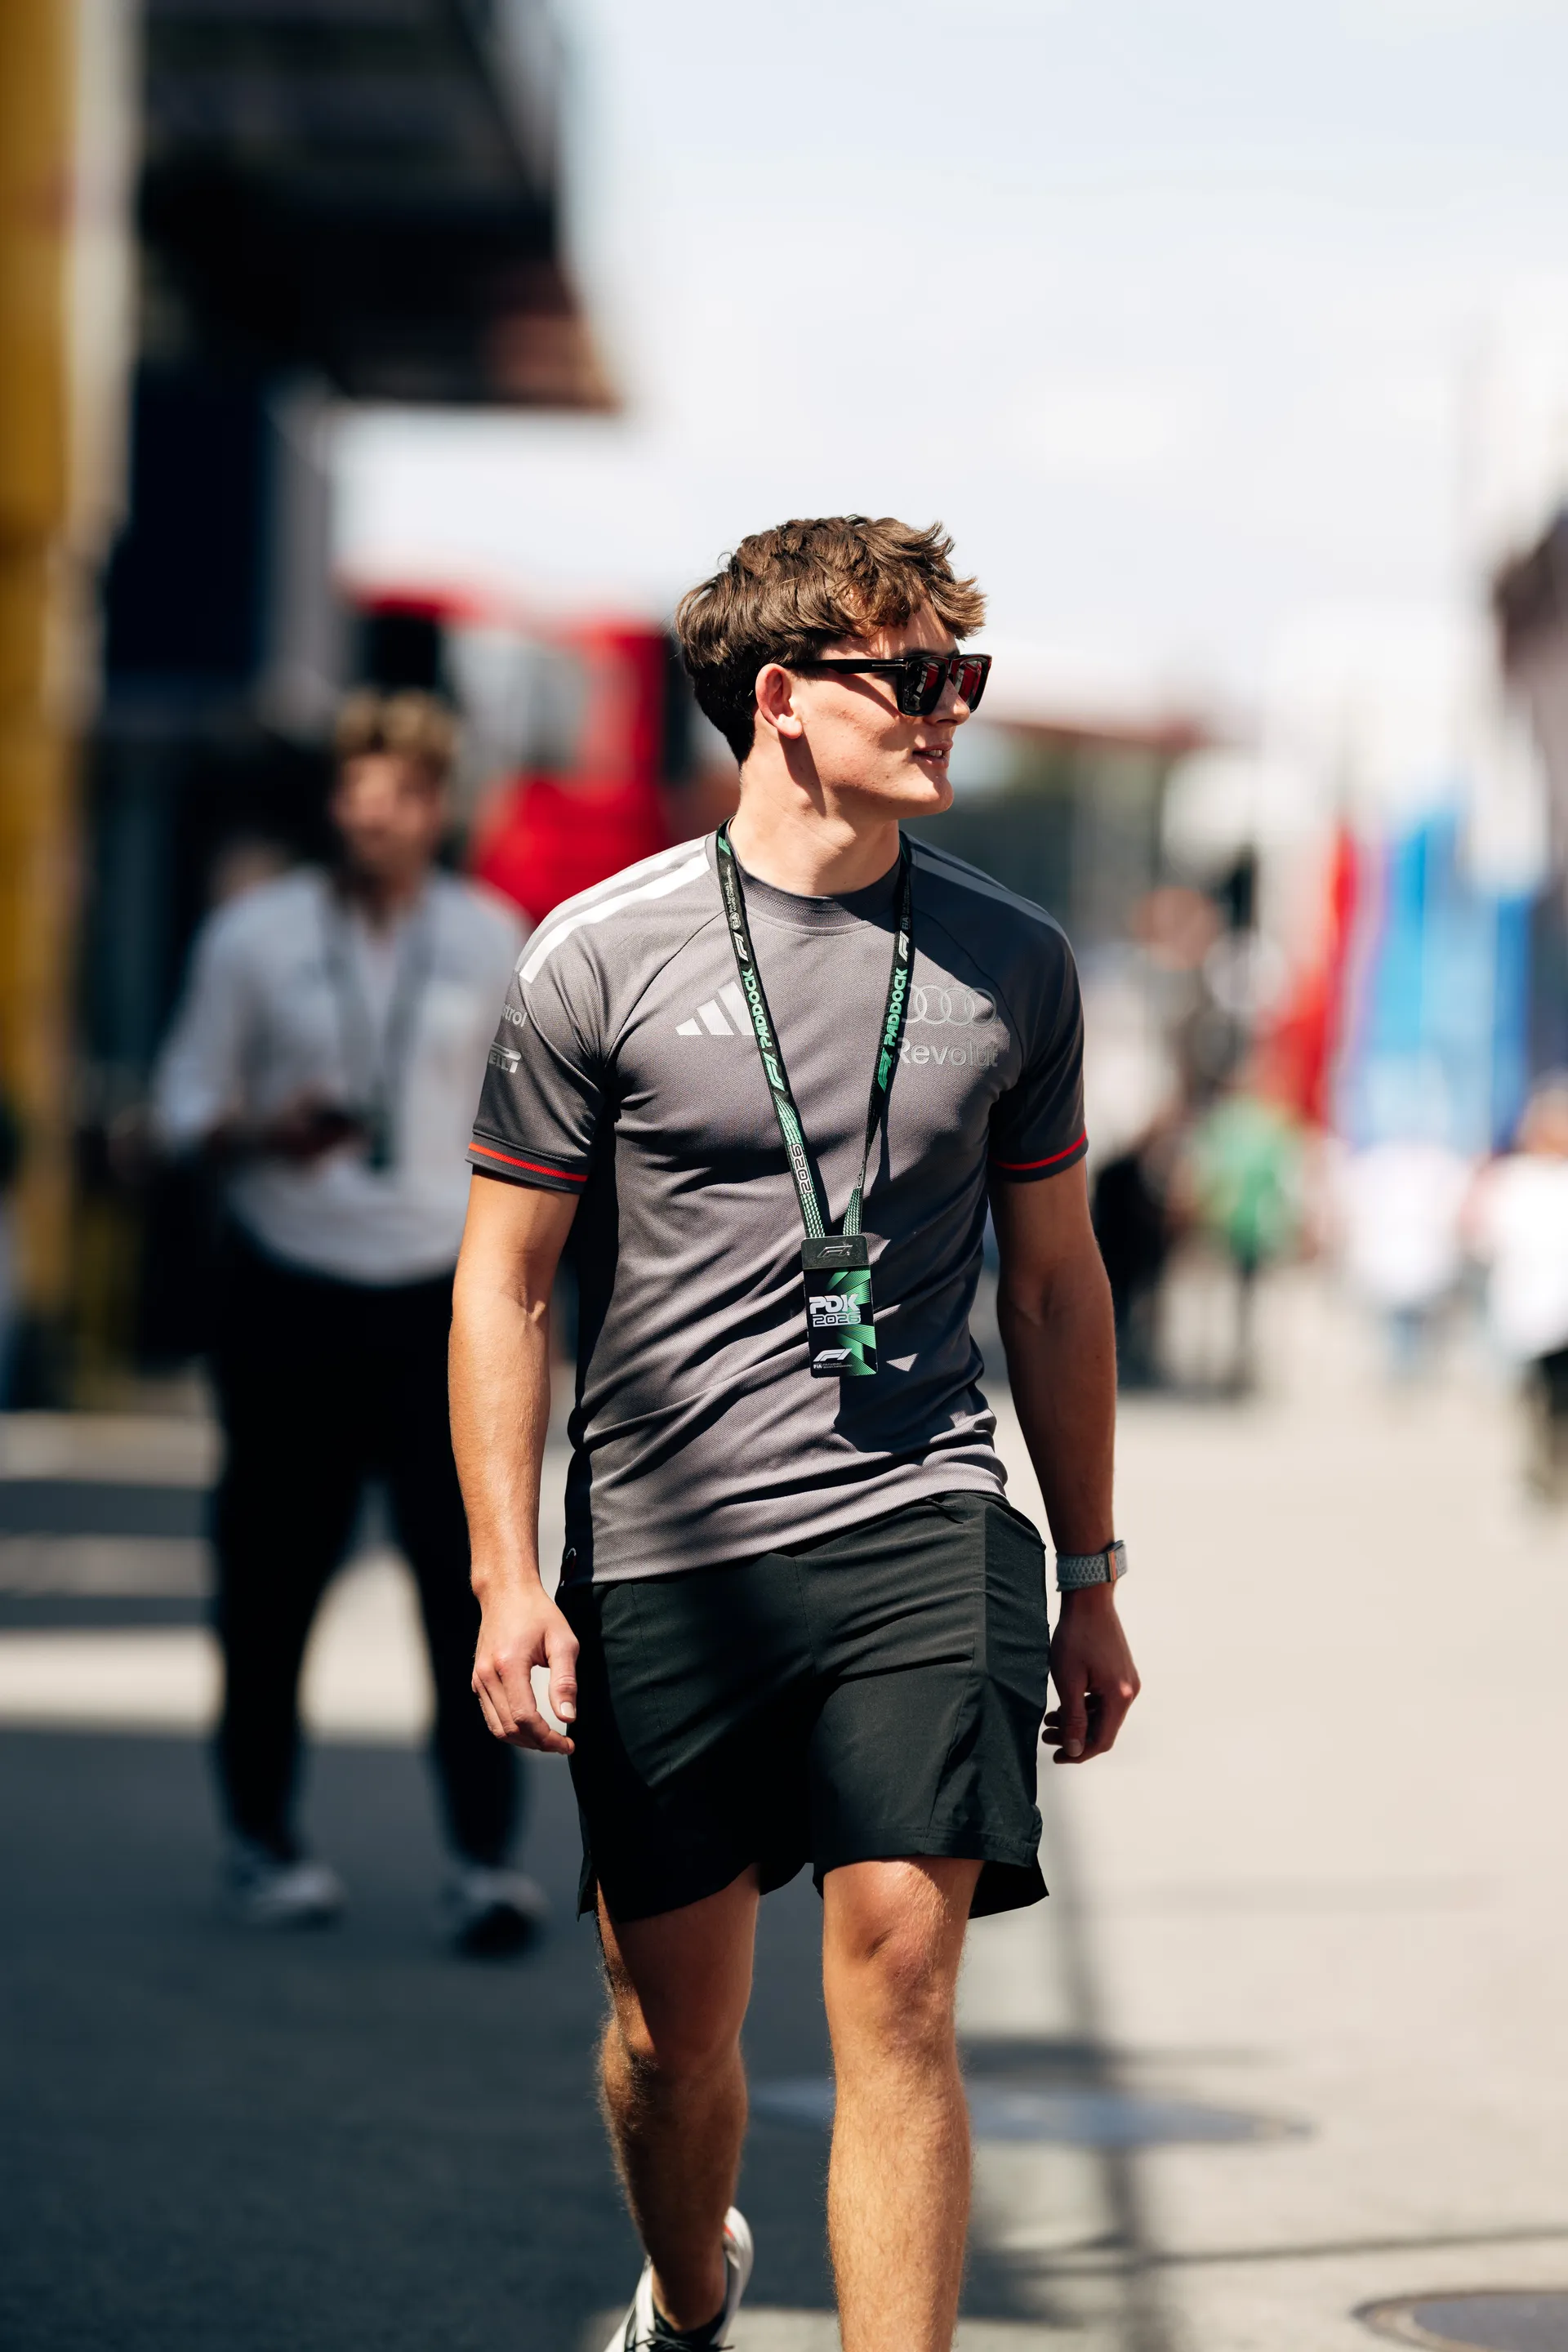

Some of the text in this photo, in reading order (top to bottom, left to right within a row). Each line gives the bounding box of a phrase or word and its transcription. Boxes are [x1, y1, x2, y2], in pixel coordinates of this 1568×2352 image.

[733, 932, 749, 961] F1
[898, 930, 910, 962] F1
[743, 968, 773, 1048] PADDOCK
[884, 968, 908, 1047] PADDOCK
[894, 1037, 998, 1067] Revolut
[790, 1143, 813, 1195] 2026
[809, 1294, 861, 1315] PDK
[813, 1314, 861, 1327] 2026
[813, 1348, 853, 1362] F1
